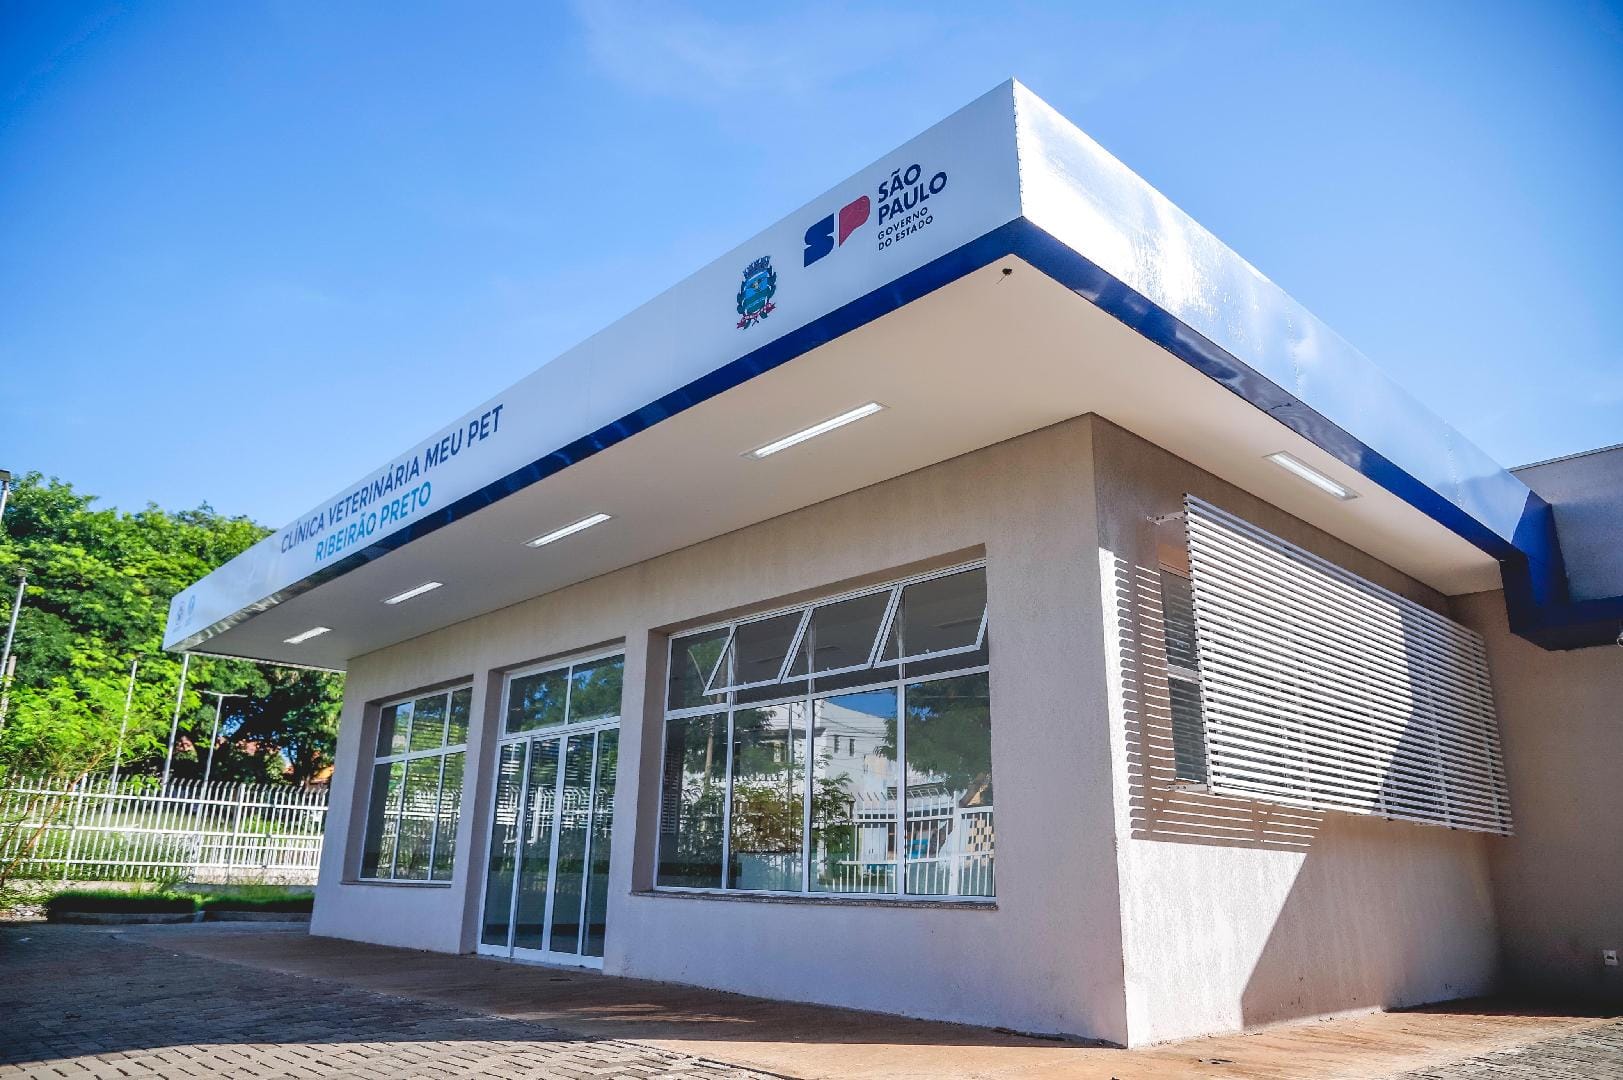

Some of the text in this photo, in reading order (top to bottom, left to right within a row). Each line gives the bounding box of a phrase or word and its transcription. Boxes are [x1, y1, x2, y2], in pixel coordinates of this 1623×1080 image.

[878, 163, 921, 204] SÃO
[878, 171, 948, 226] PAULO
[804, 195, 870, 268] SP
[877, 207, 928, 240] GOVERNO
[878, 215, 934, 251] DO ESTADO
[281, 404, 504, 554] CLÍNICA VETERINÁRIA MEU PET
[315, 481, 432, 563] RIBEIRÃO PRETO
